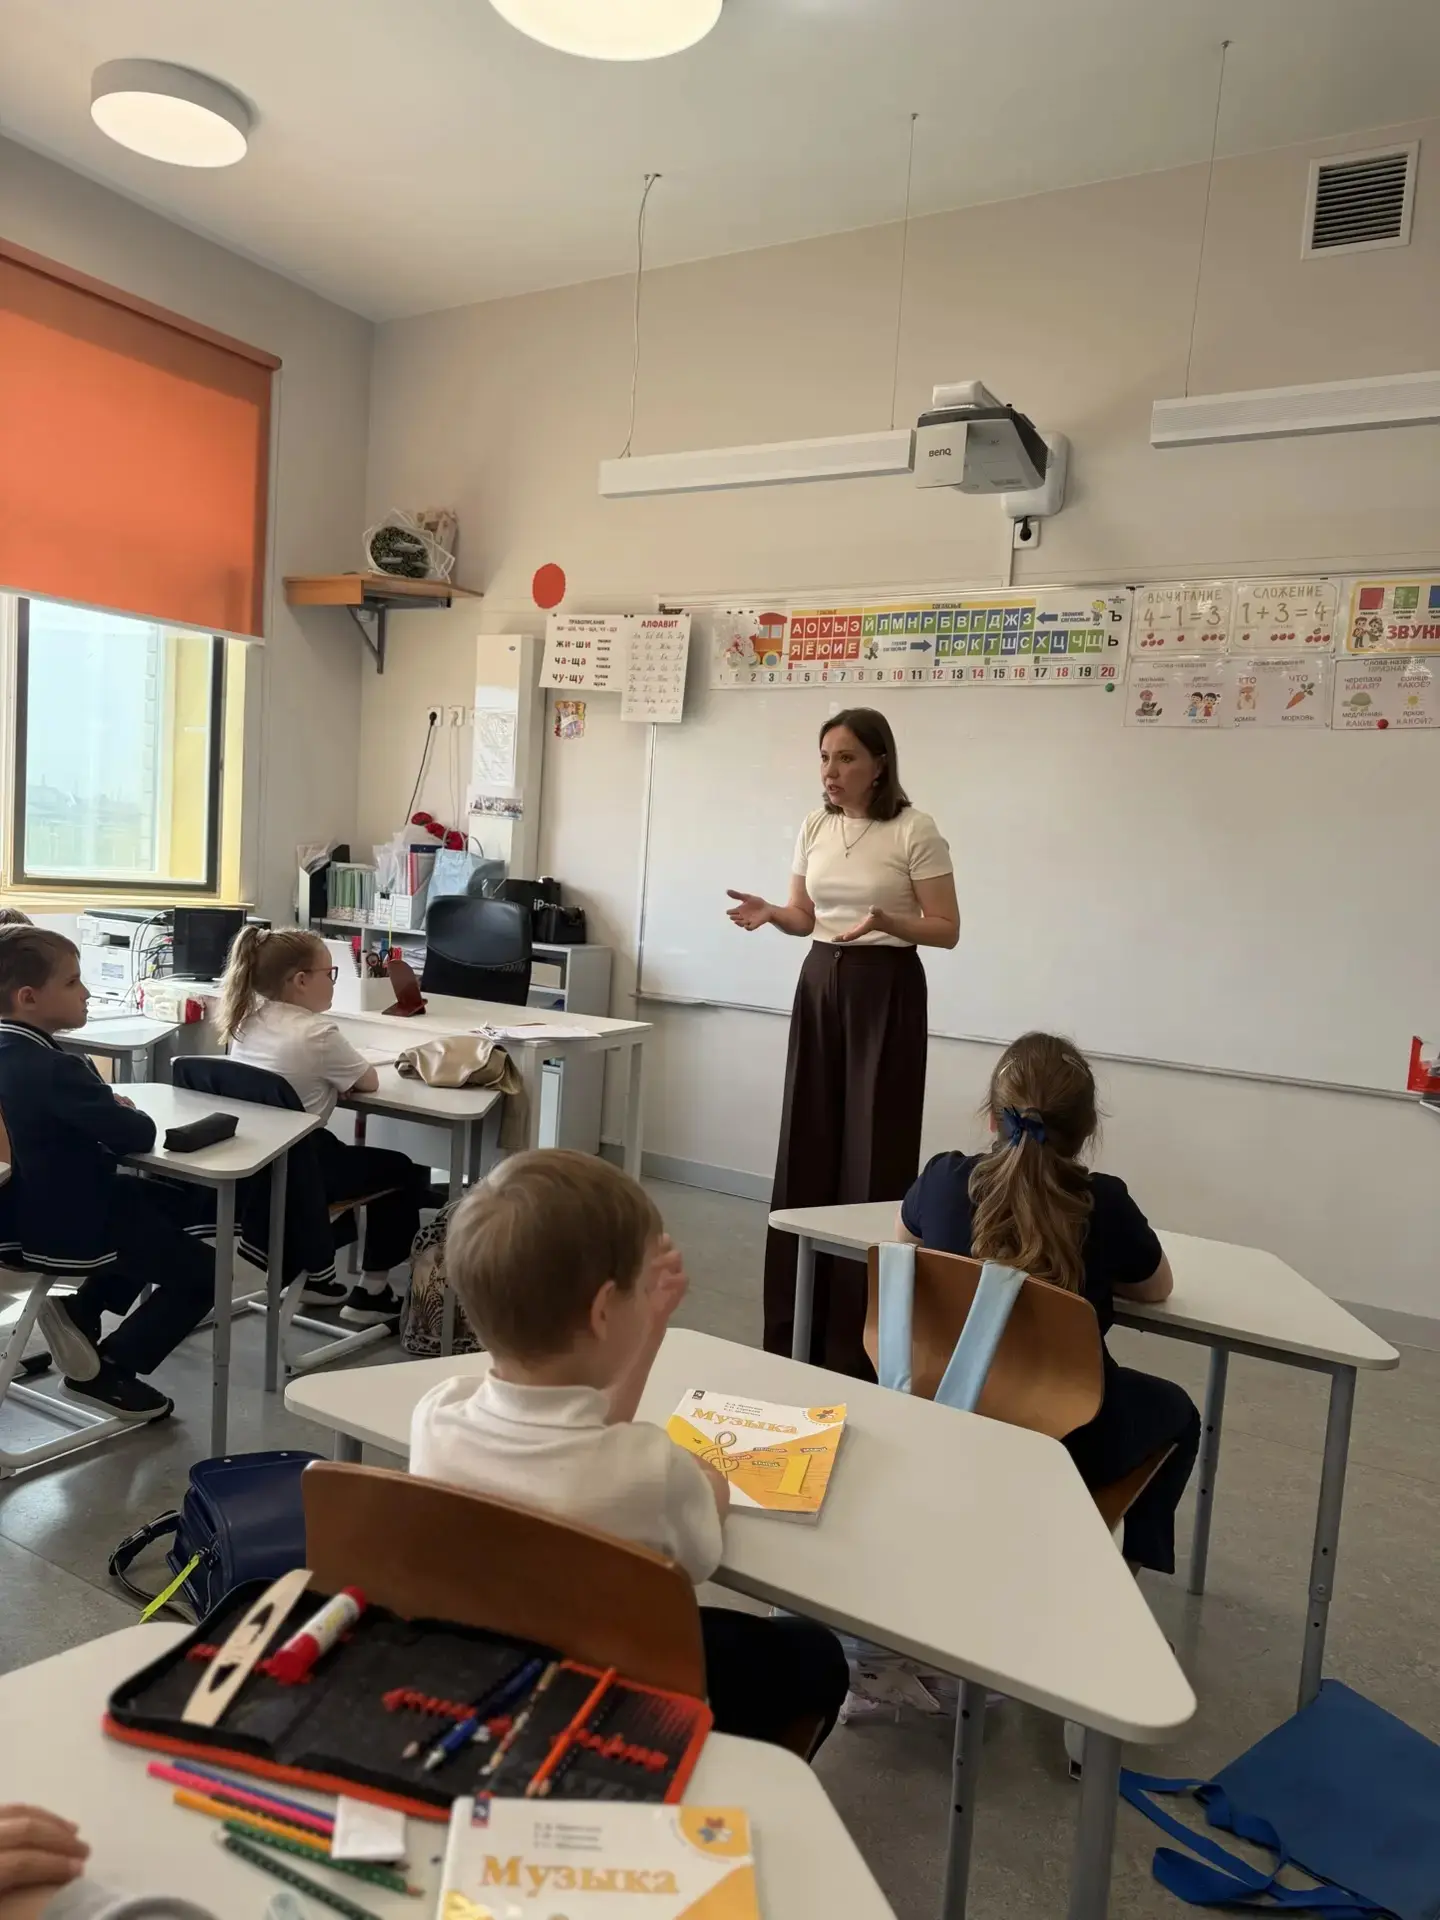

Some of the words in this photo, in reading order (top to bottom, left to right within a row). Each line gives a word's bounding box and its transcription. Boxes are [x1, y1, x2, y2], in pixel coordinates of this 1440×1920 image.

[928, 448, 952, 458] BenQ
[1147, 589, 1223, 604] ВЫЧИТАНИЕ
[1253, 585, 1323, 599] СЛОЖЕНИЕ
[1144, 608, 1155, 627] 4
[1176, 606, 1183, 626] 1
[1206, 606, 1221, 625] 3
[1242, 602, 1250, 623] 1
[1274, 603, 1289, 622] 3
[1314, 602, 1327, 621] 4
[641, 620, 678, 628] АЛФАВИТ
[750, 672, 757, 682] 2
[768, 672, 775, 682] 3
[804, 672, 810, 681] 5
[822, 672, 828, 681] 6
[840, 672, 846, 681] 7
[893, 670, 903, 680] 10
[912, 670, 922, 680] 11
[932, 670, 944, 679] 12
[951, 669, 963, 679] 13
[972, 668, 984, 679] 14
[993, 668, 1005, 679] 15
[1014, 668, 1025, 678] 16
[1034, 668, 1047, 677] 17
[1056, 667, 1069, 677] 18
[1078, 666, 1092, 677] 19
[1101, 667, 1115, 677] 20
[690, 1407, 799, 1434] Музыка
[478, 1854, 680, 1898] Музыка
